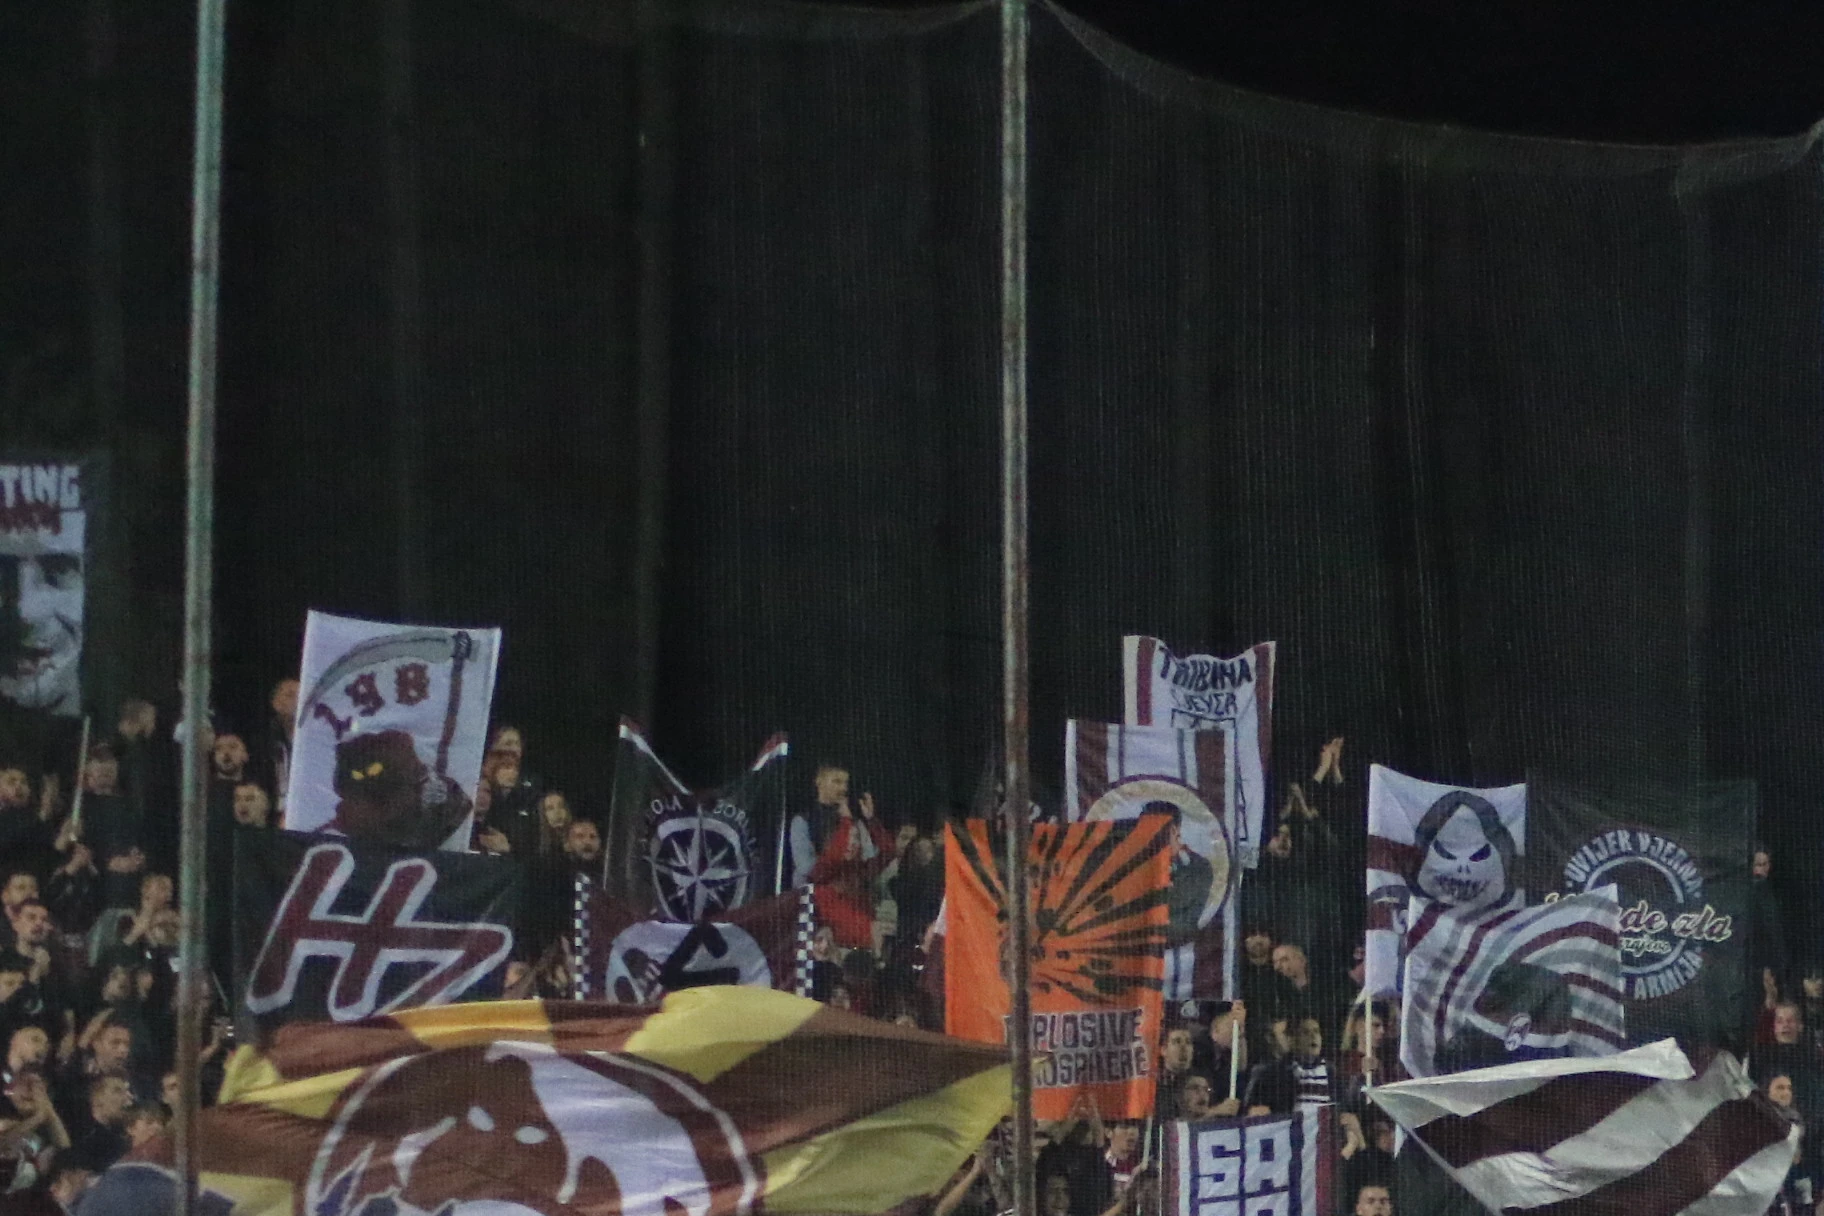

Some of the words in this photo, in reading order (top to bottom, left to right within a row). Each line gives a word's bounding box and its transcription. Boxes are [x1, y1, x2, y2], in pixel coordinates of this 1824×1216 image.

[1171, 690, 1239, 716] JEVER
[1003, 1006, 1145, 1050] PLOSIVE
[1031, 1045, 1149, 1089] OSPHERE
